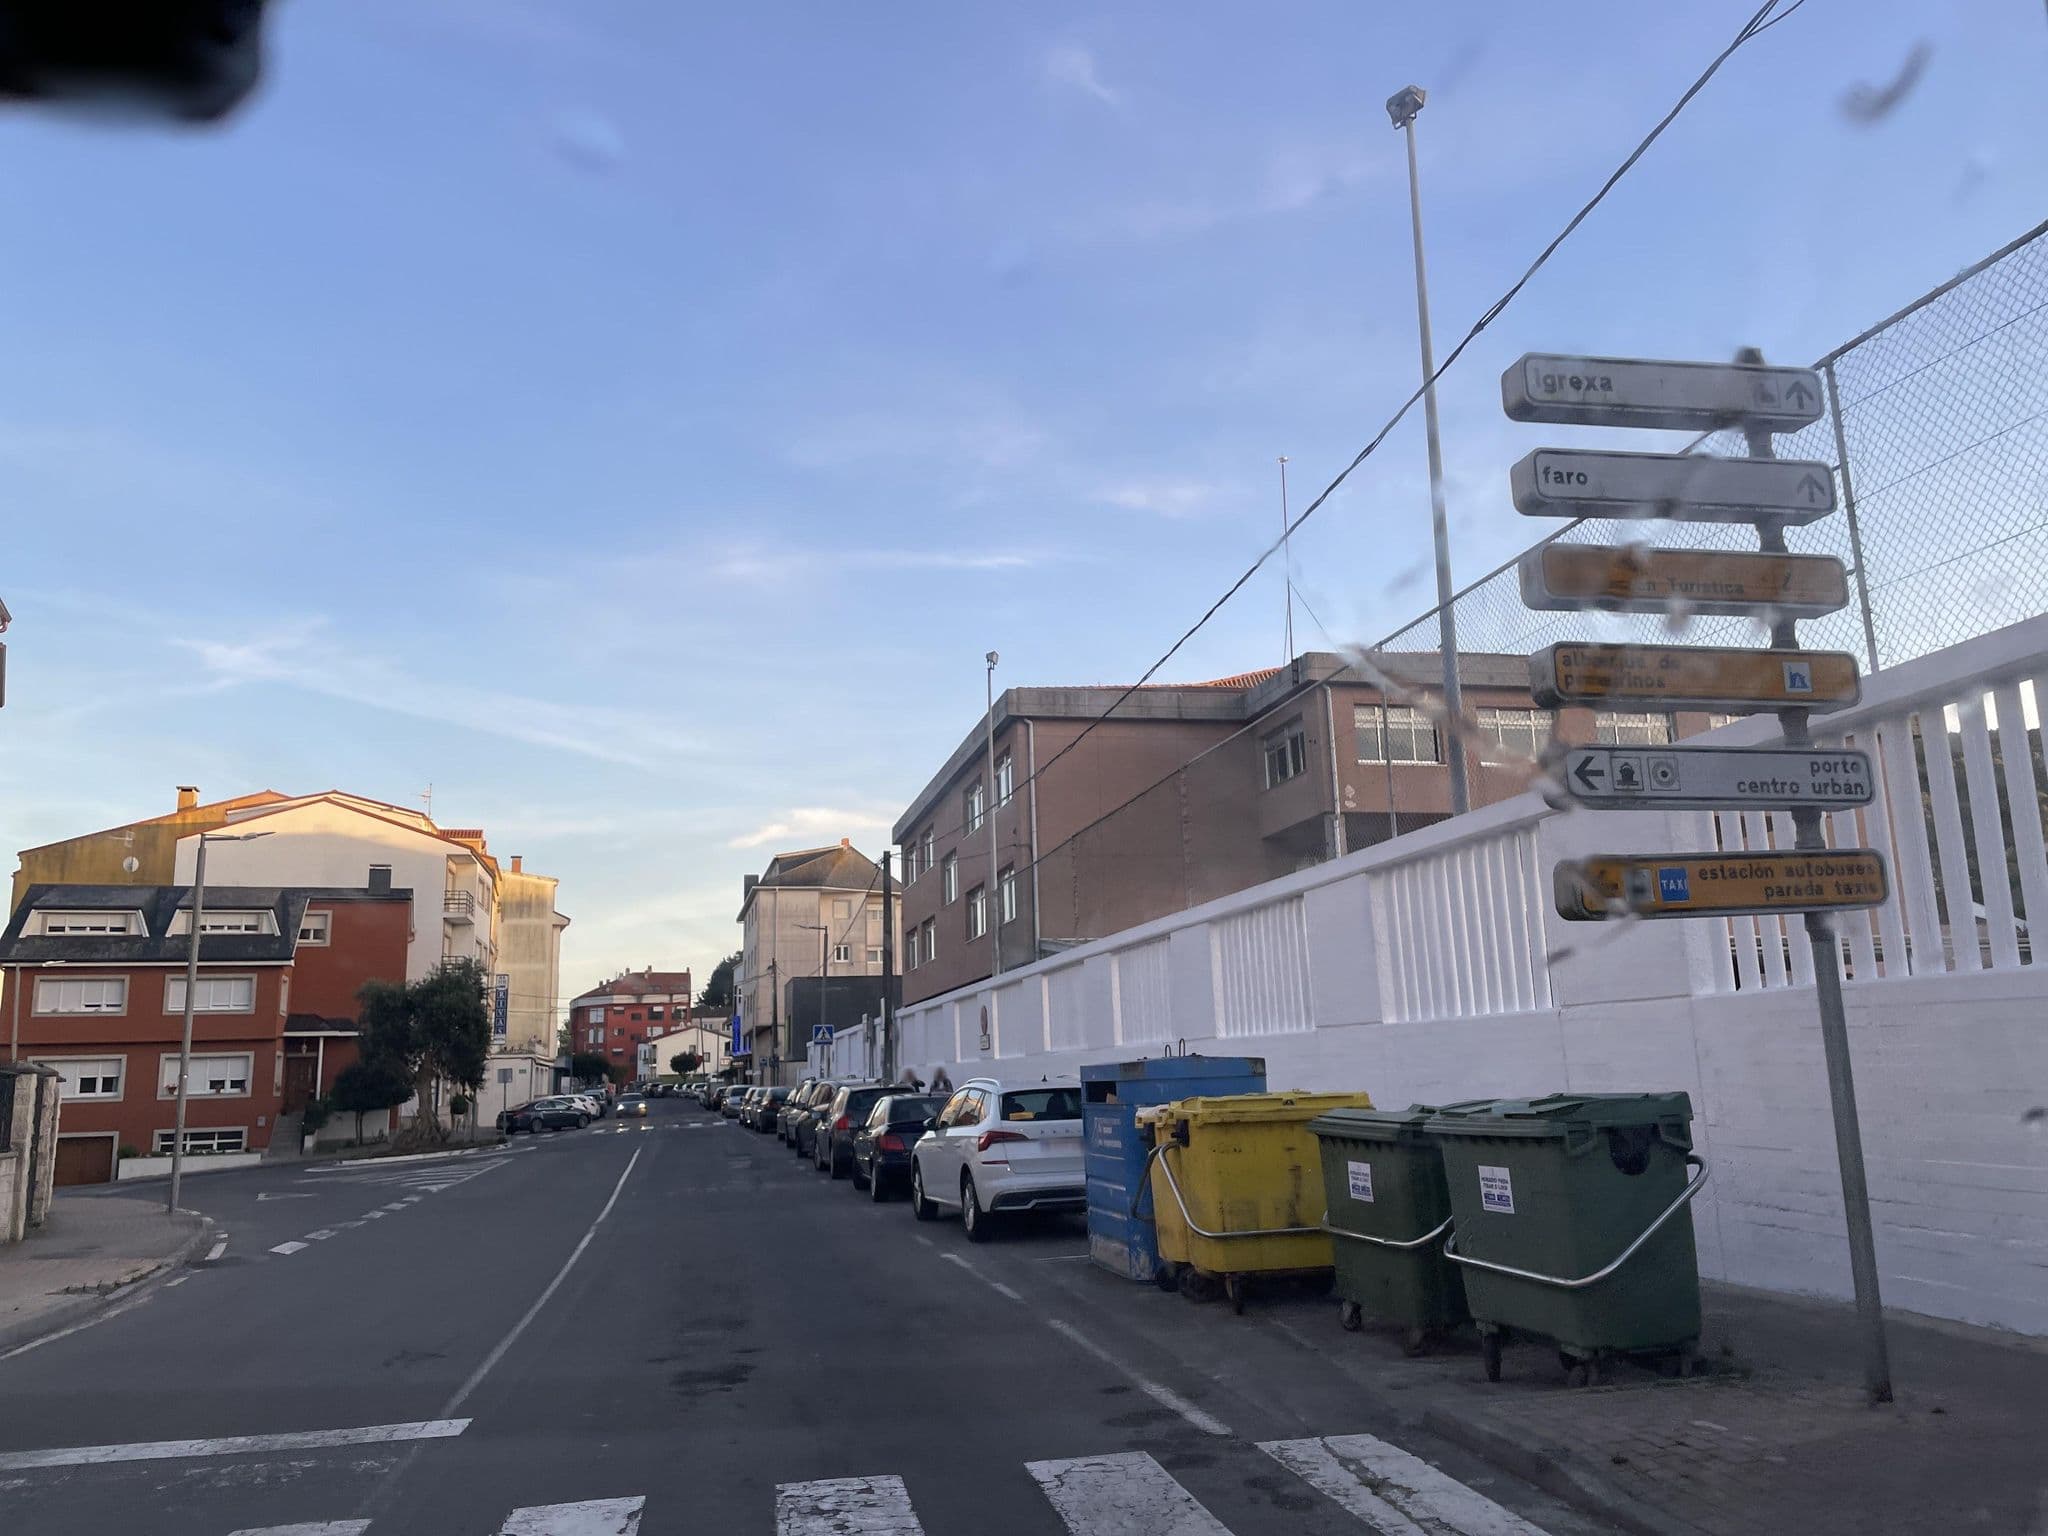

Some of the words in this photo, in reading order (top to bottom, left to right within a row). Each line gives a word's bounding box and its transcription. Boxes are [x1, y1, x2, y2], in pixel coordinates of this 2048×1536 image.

[1542, 466, 1588, 486] faro
[1810, 758, 1861, 777] porto
[1737, 777, 1799, 795] centro
[1785, 861, 1876, 879] autobuses
[1763, 881, 1824, 900] parada
[1834, 879, 1878, 896] taxis
